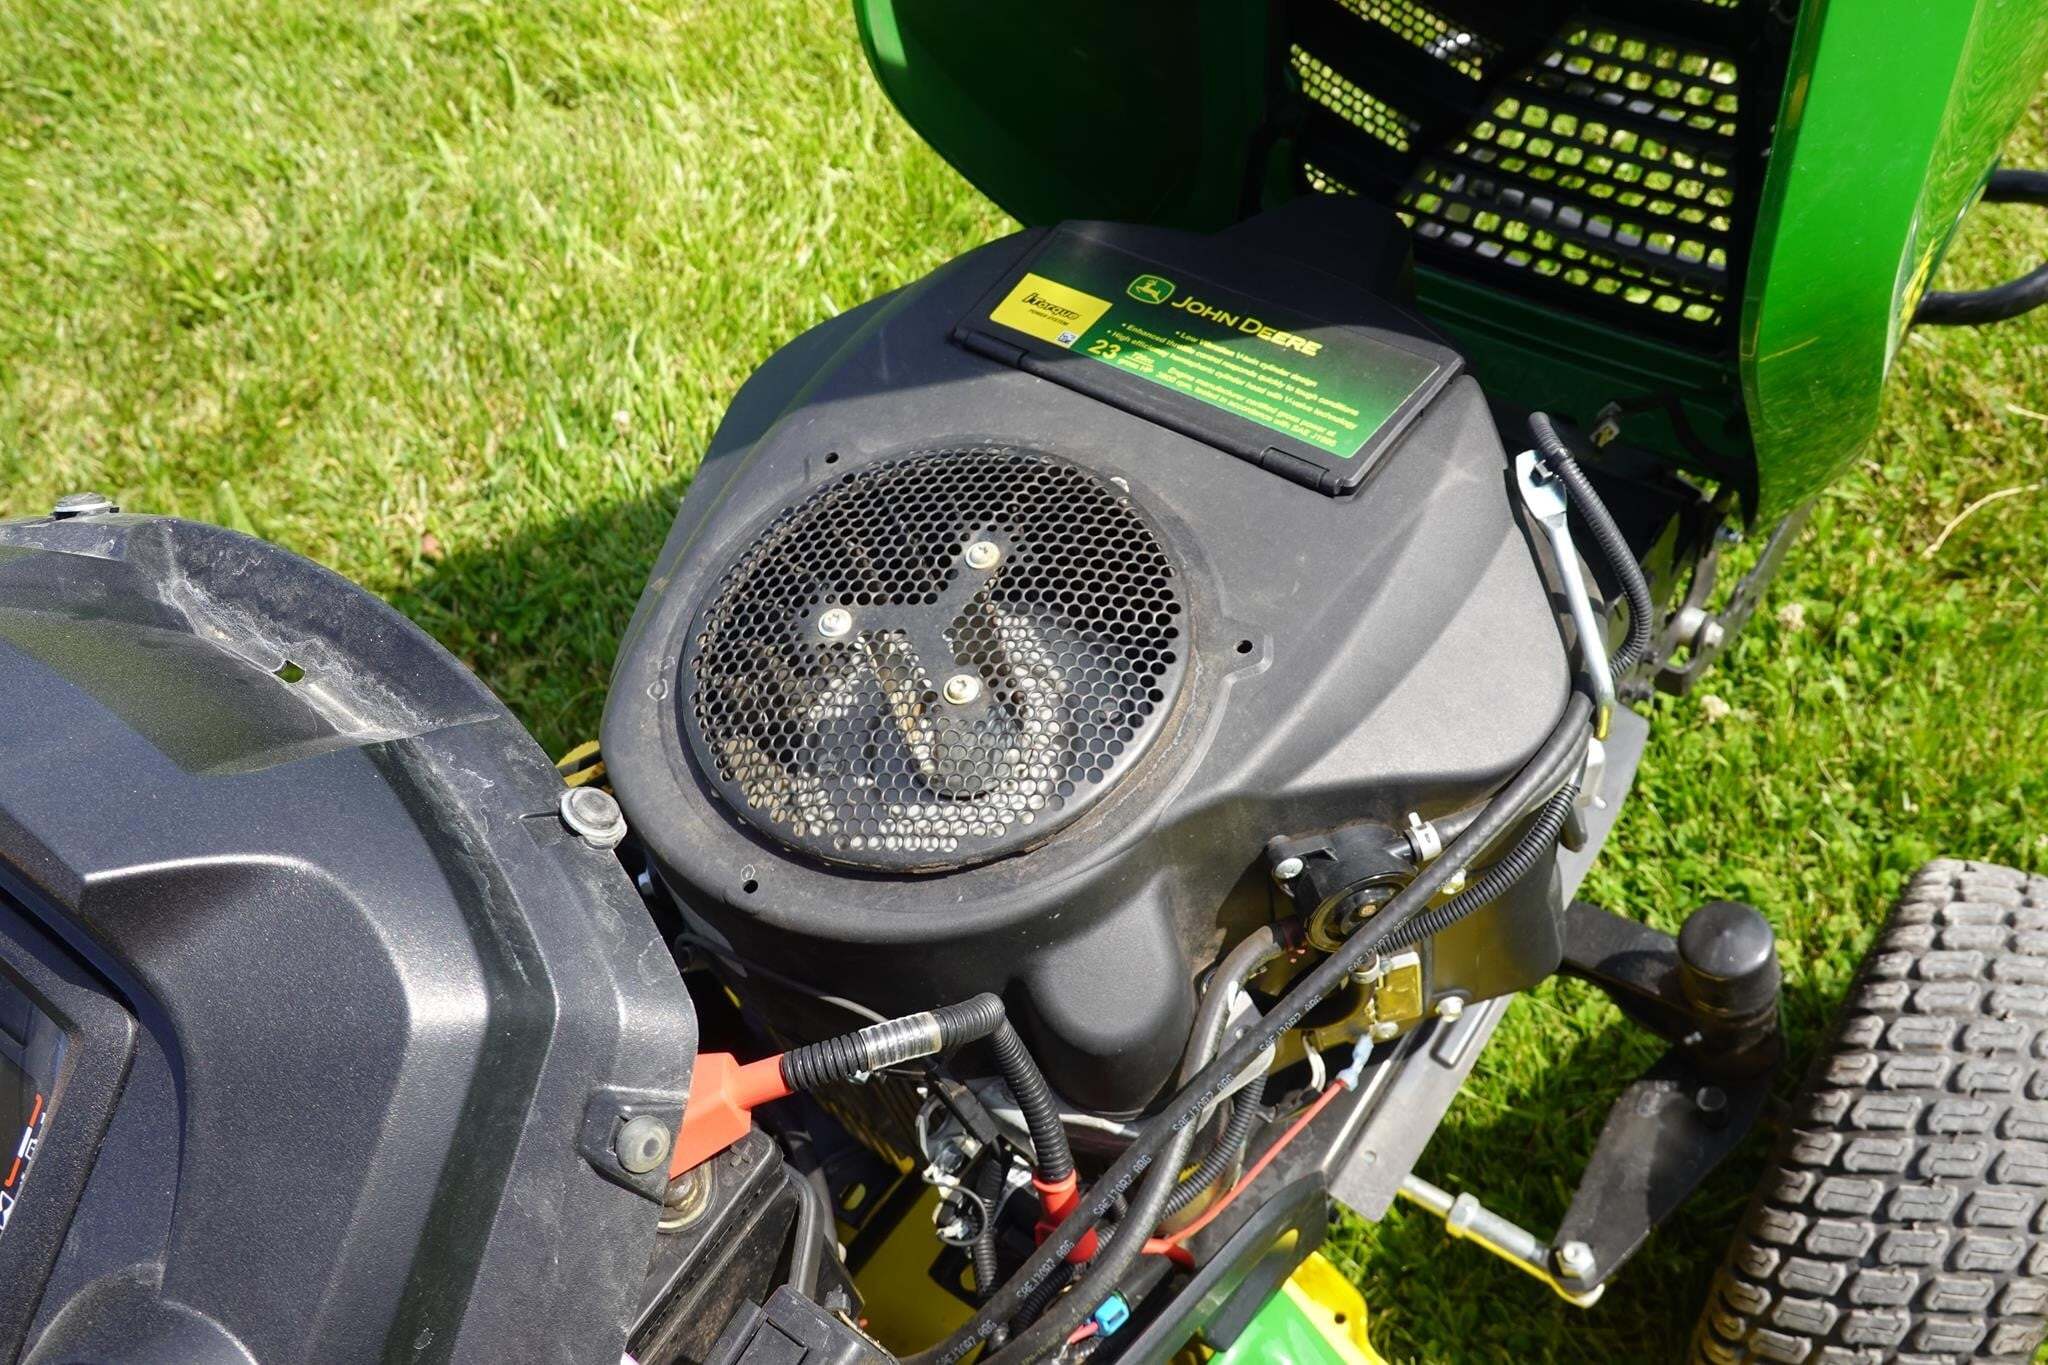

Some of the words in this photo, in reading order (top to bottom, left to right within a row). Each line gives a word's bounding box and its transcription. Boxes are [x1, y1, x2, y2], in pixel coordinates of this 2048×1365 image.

[1021, 292, 1081, 321] iTorque
[1171, 296, 1240, 327] JOHN
[1238, 317, 1323, 357] DEERE
[1087, 338, 1122, 361] 23
[1125, 324, 1167, 343] Enhanced
[1254, 373, 1288, 390] quickly
[1283, 384, 1296, 392] to
[1291, 387, 1320, 402] tough
[1316, 396, 1361, 416] conditions
[1165, 366, 1197, 383] Engine
[1179, 332, 1199, 343] Low
[1256, 361, 1292, 378] cylinder
[1287, 372, 1319, 388] design
[1110, 331, 1132, 343] High
[1128, 338, 1170, 358] efficiency
[1211, 370, 1246, 387] cylinder
[1243, 381, 1267, 394] head
[1264, 389, 1285, 400] with
[1310, 407, 1359, 430] technology
